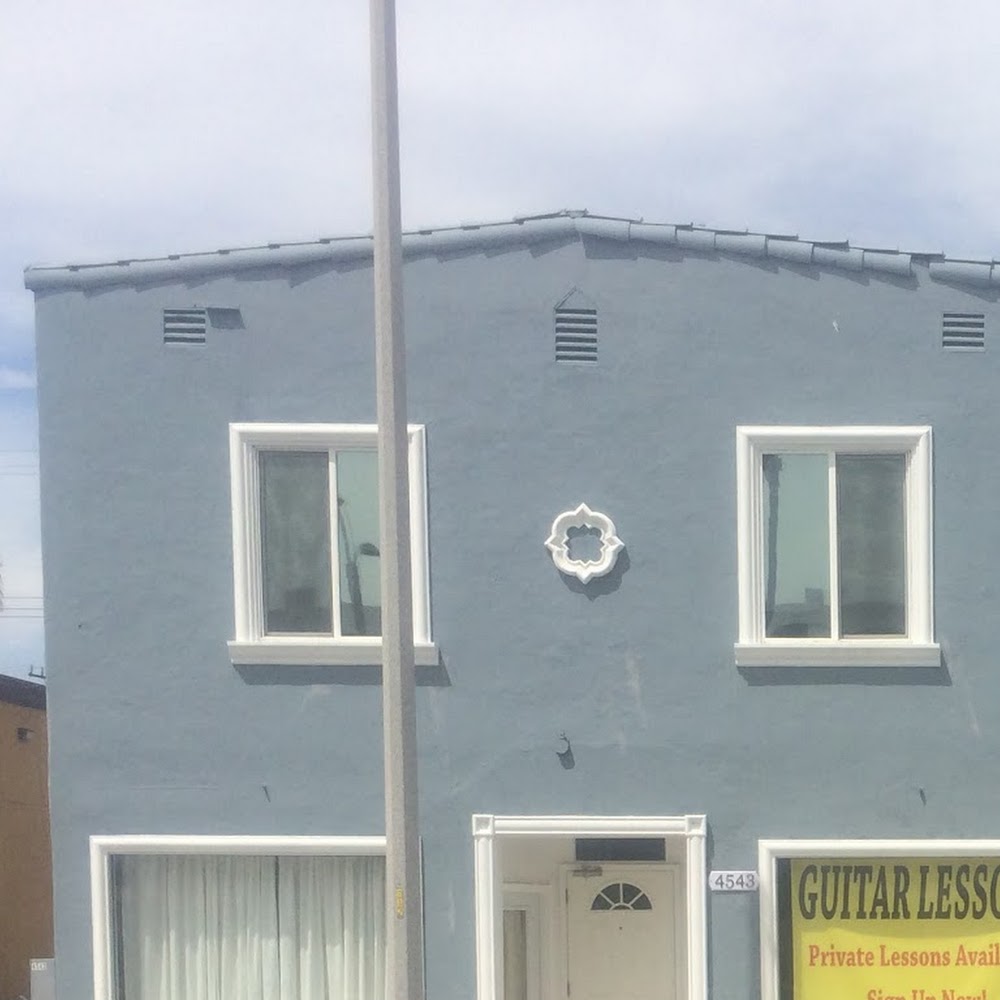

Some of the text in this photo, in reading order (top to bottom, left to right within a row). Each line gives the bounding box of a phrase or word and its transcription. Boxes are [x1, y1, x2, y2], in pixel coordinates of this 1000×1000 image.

[714, 874, 756, 889] 4543
[798, 864, 911, 920] GUITAR
[808, 944, 875, 967] Private
[879, 944, 951, 967] Lessons
